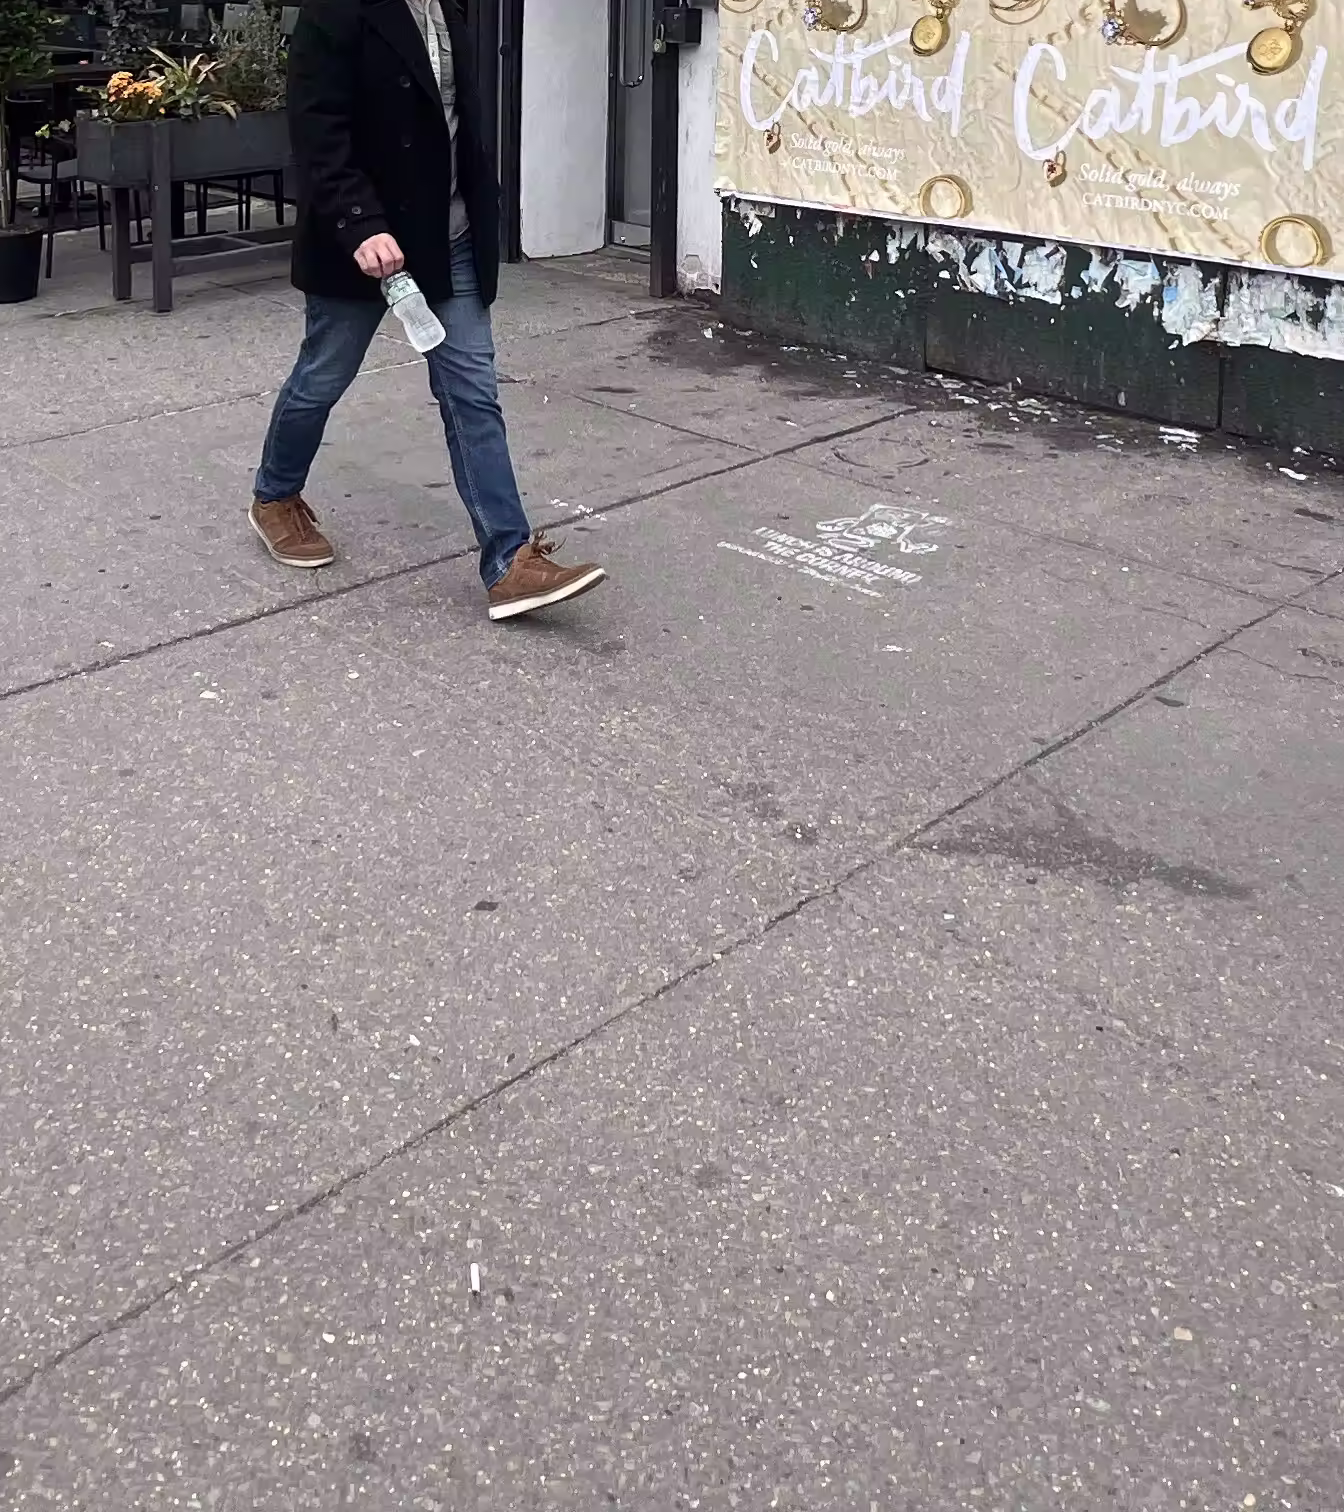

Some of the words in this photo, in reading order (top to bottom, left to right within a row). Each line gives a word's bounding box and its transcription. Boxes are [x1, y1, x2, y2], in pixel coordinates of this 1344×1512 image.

[739, 27, 970, 137] Catbird
[1013, 41, 1328, 171] Catbird
[1079, 162, 1122, 188] Solid
[1175, 173, 1242, 198] always
[1082, 192, 1230, 221] CATBIRDNYC.COM
